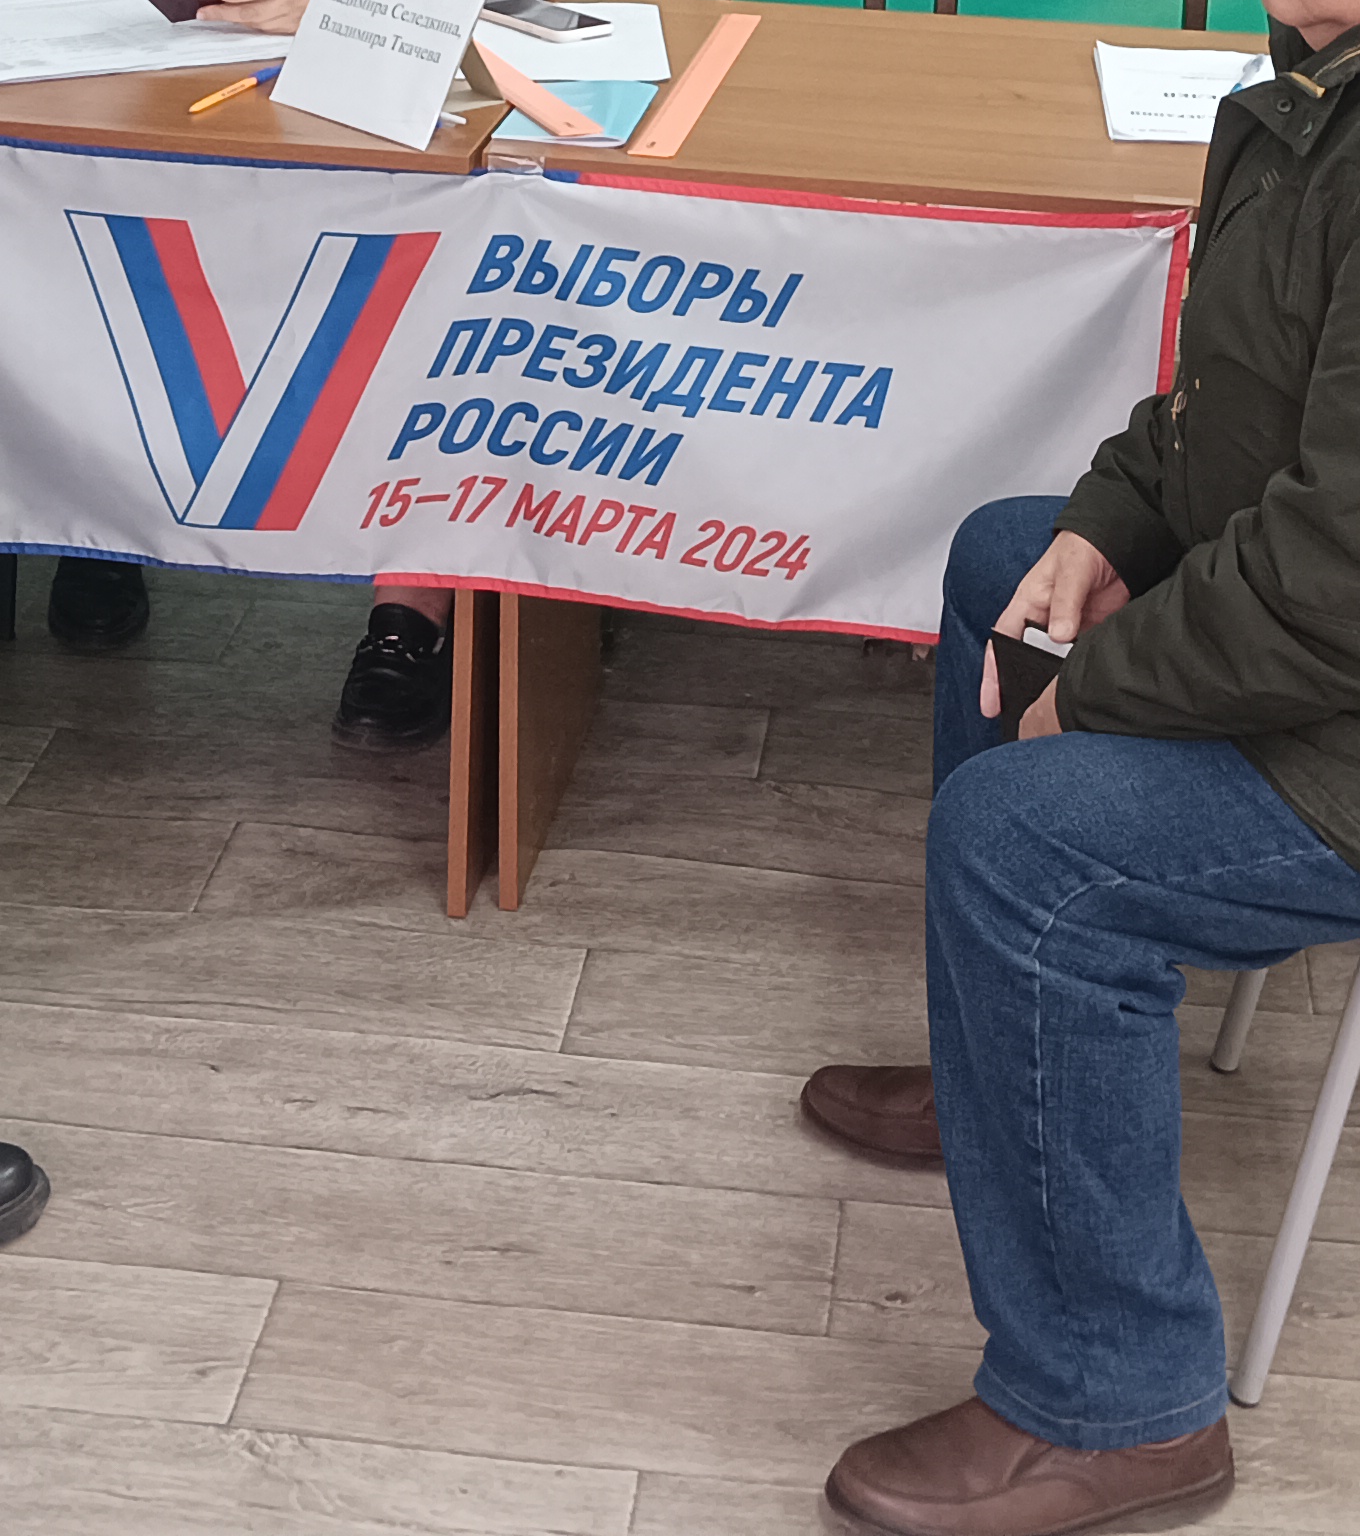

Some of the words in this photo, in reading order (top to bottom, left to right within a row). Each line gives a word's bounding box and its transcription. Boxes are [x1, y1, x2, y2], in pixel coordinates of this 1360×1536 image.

[319, 14, 387, 49] Владимира
[390, 35, 442, 64] Ткачева
[391, 3, 462, 39] Селедкина,
[466, 234, 804, 328] ВЫБОРЫ
[426, 317, 894, 429] ПРЕЗИДЕНТА
[387, 398, 684, 487] РОССИИ
[505, 483, 678, 561] МАРТА
[680, 519, 814, 582] 2024
